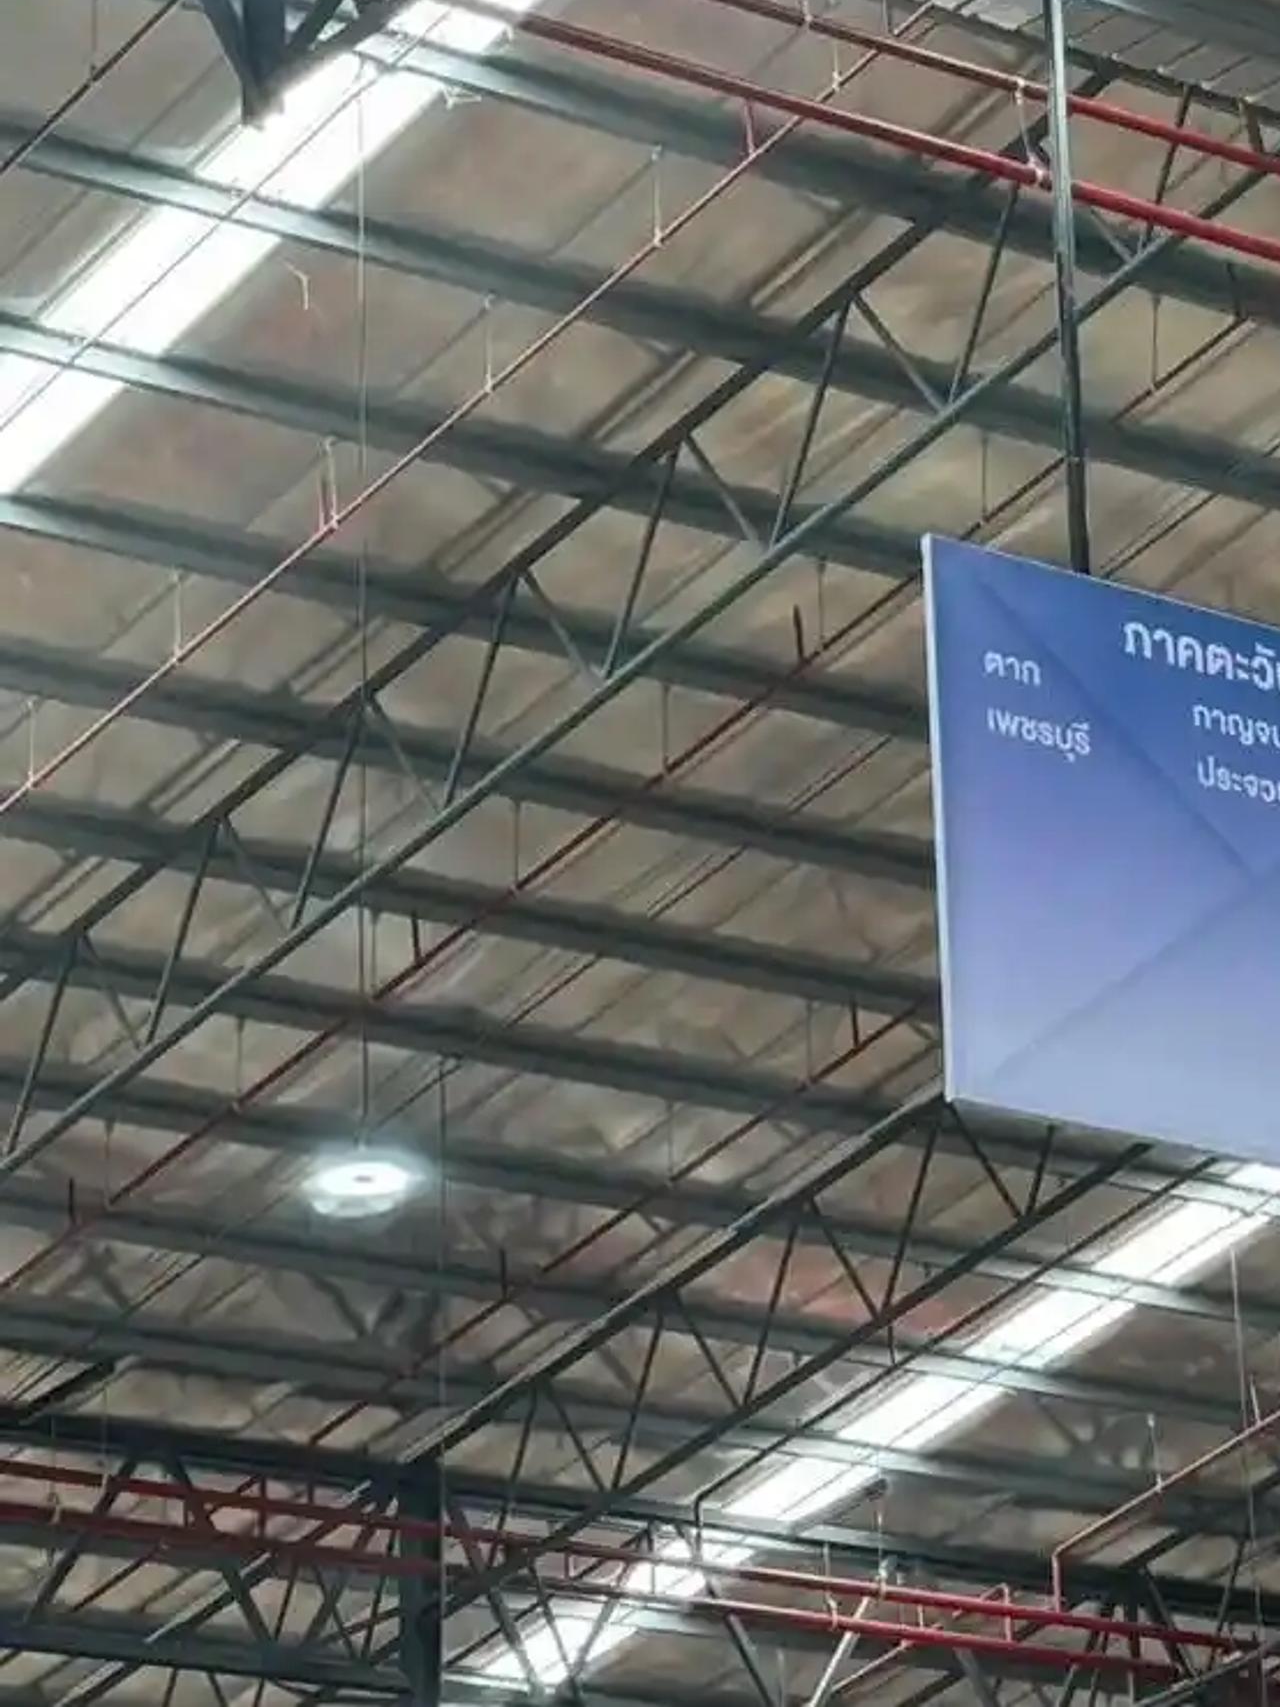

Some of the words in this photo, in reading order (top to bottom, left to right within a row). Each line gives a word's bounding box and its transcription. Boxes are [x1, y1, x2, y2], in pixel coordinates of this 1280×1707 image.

[983, 651, 1042, 686] ตาก
[987, 707, 1090, 762] เพชรบุรี
